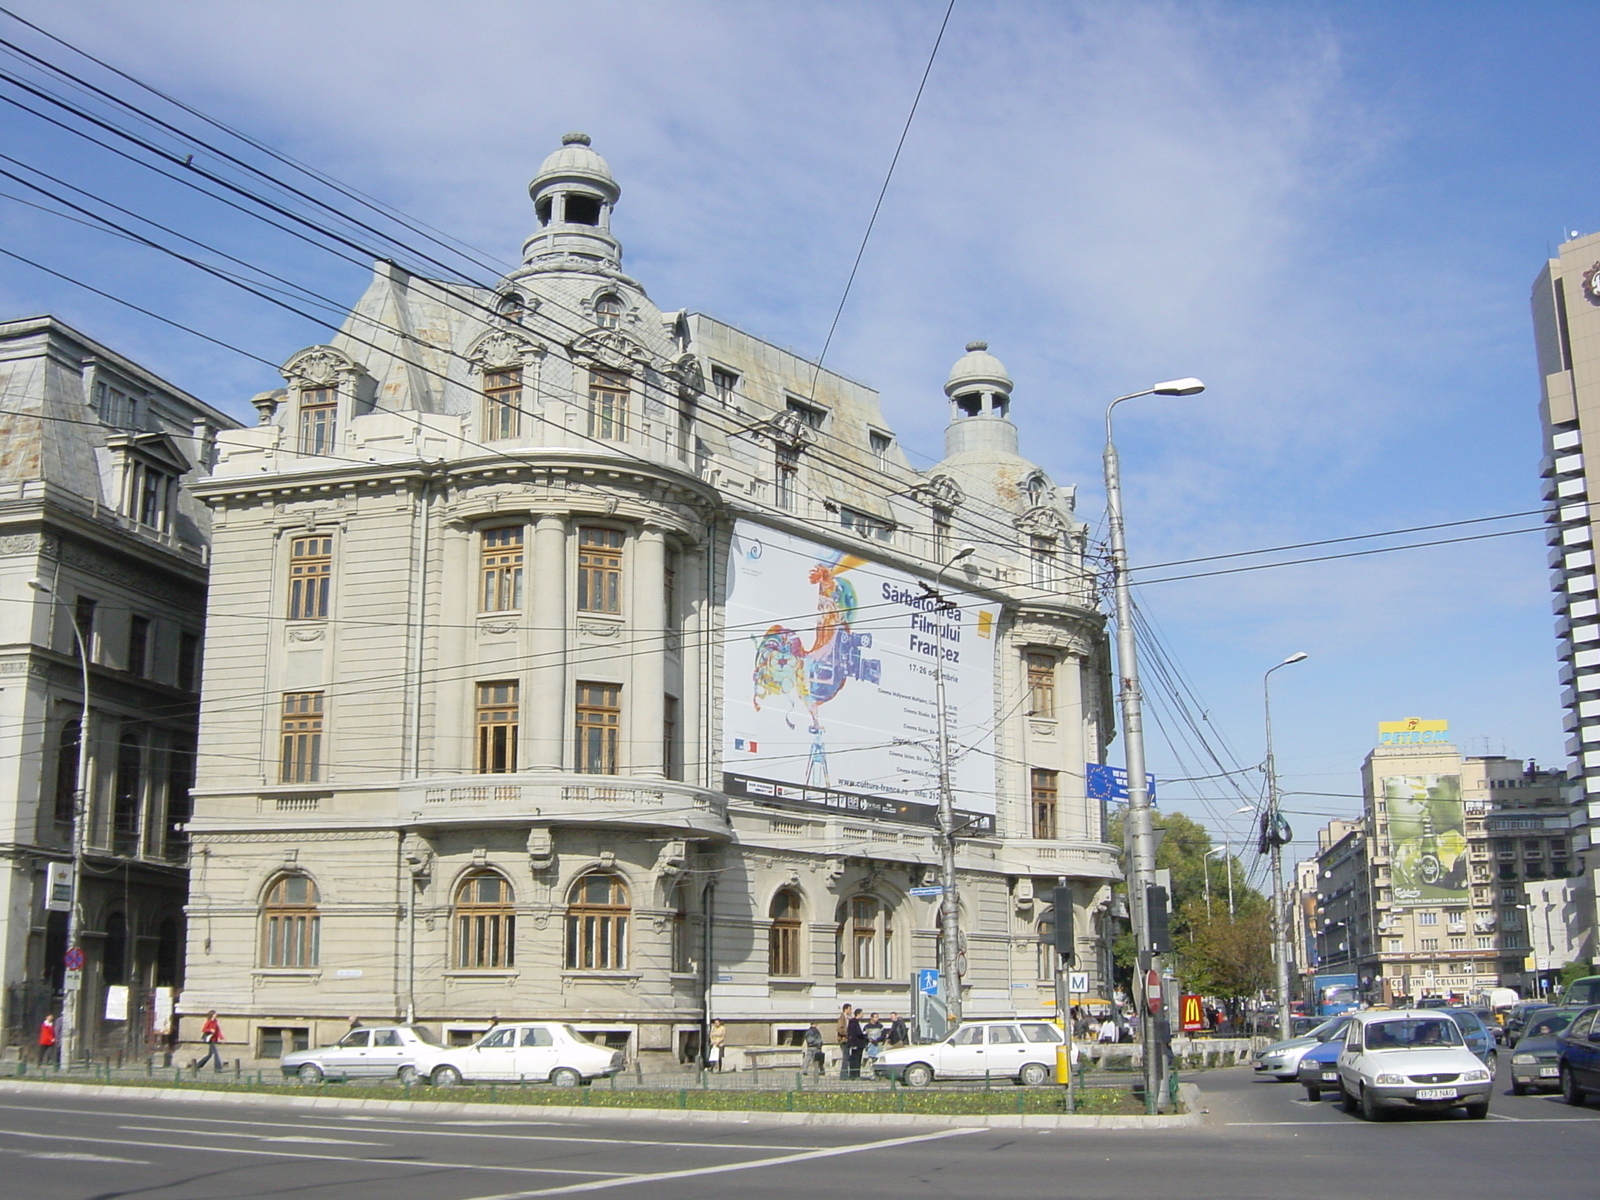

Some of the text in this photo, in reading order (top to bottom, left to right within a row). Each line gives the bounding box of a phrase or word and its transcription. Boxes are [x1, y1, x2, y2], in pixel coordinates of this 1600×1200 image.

[881, 582, 962, 622] Sărbătorea
[910, 613, 961, 643] Filmului
[909, 634, 960, 664] Francez
[928, 671, 959, 683] ocmbrie
[1380, 730, 1449, 745] PETROM
[1072, 976, 1085, 990] M
[1391, 979, 1424, 987] CEINI
[1435, 978, 1468, 986] CELLINI
